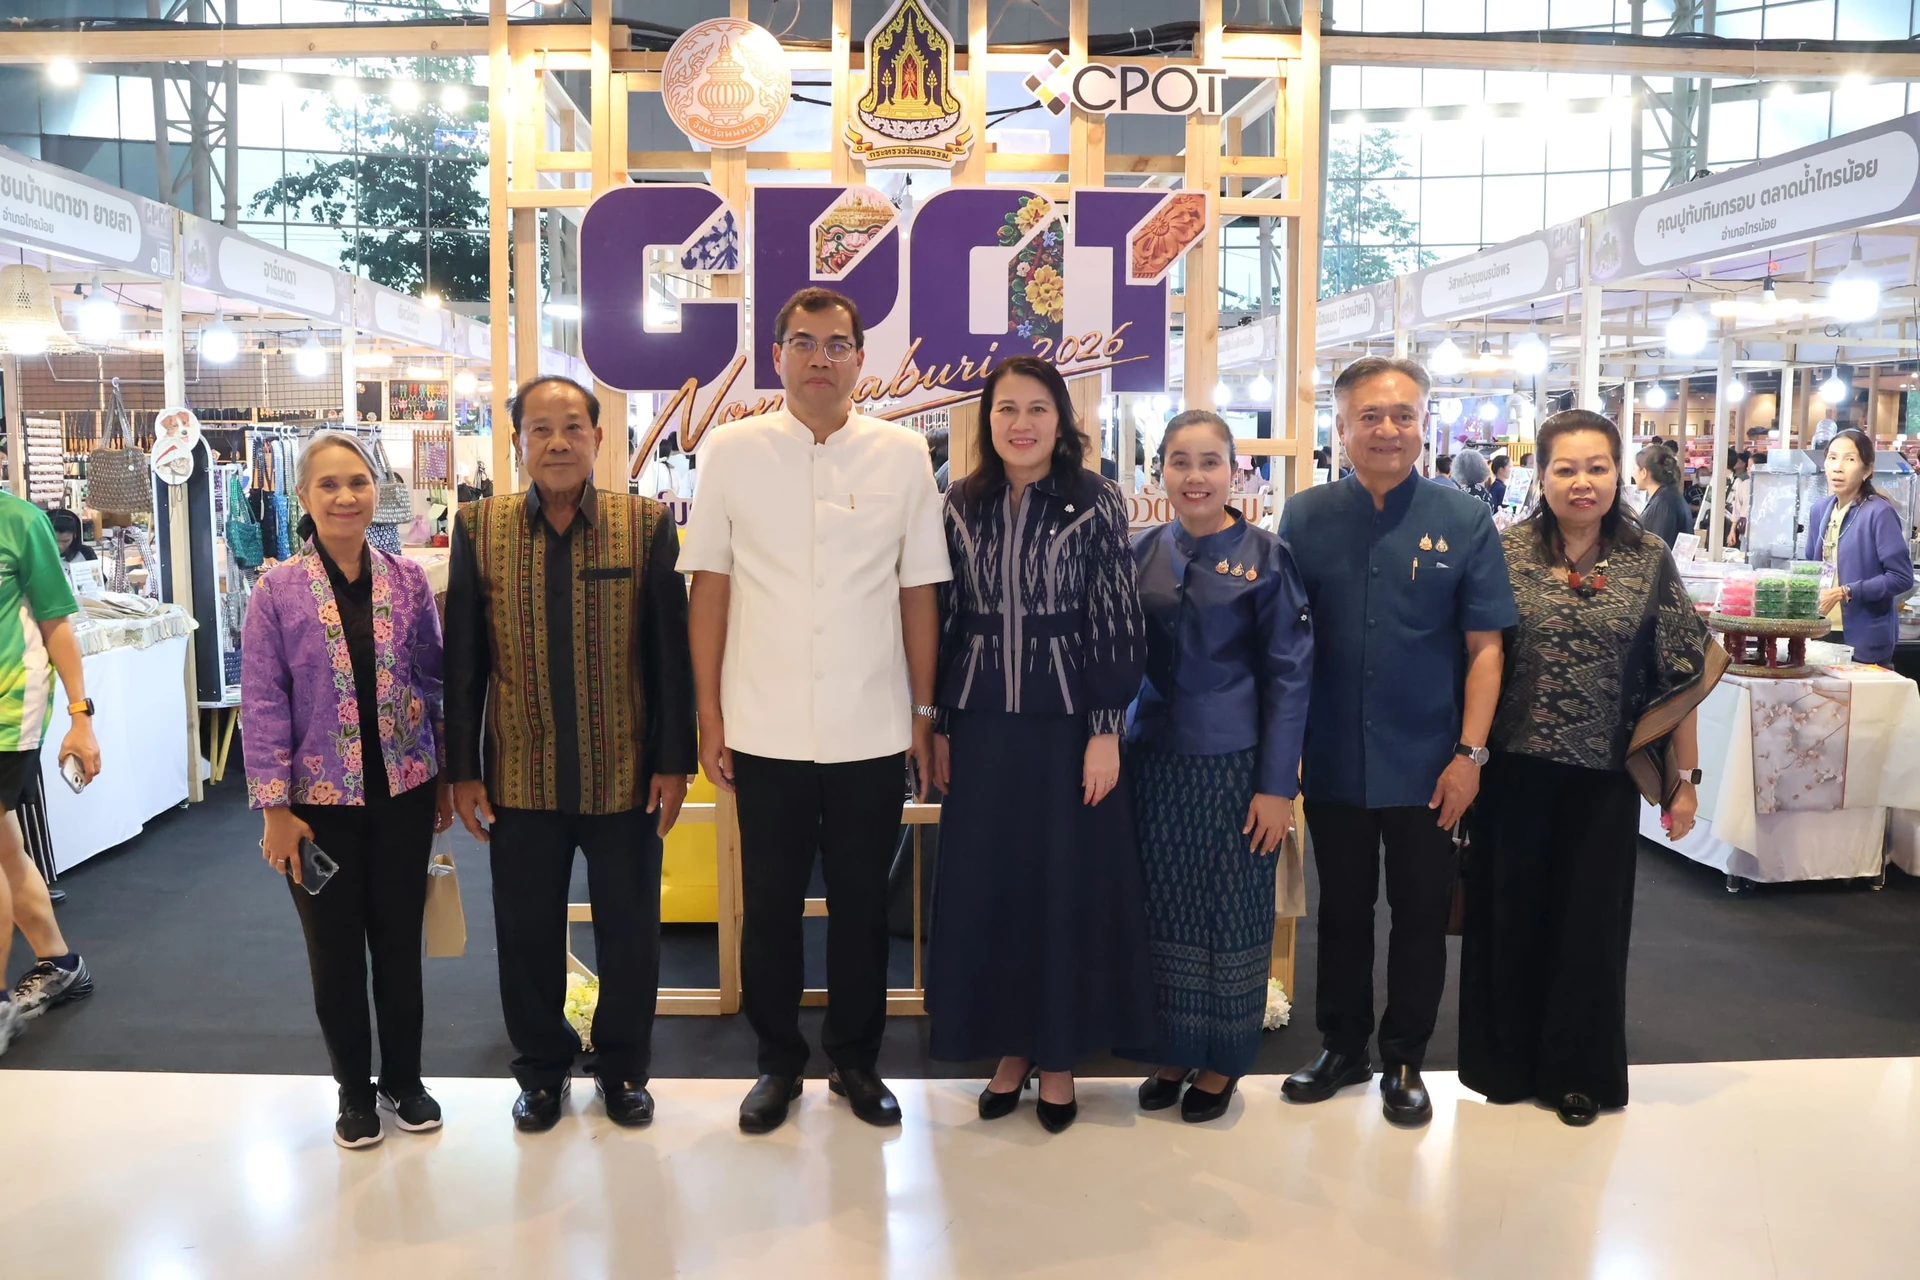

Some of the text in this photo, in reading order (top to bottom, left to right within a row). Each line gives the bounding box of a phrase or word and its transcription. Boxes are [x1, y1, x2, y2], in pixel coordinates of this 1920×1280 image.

[1073, 65, 1226, 112] CPOT
[94, 205, 132, 234] ยายสา
[1657, 158, 1878, 239] คุณปูทับทิมกรอบ ตลาดน้ำไทรน้อย
[581, 187, 1207, 392] CPOT
[631, 321, 1133, 479] Nonaburi 2026
